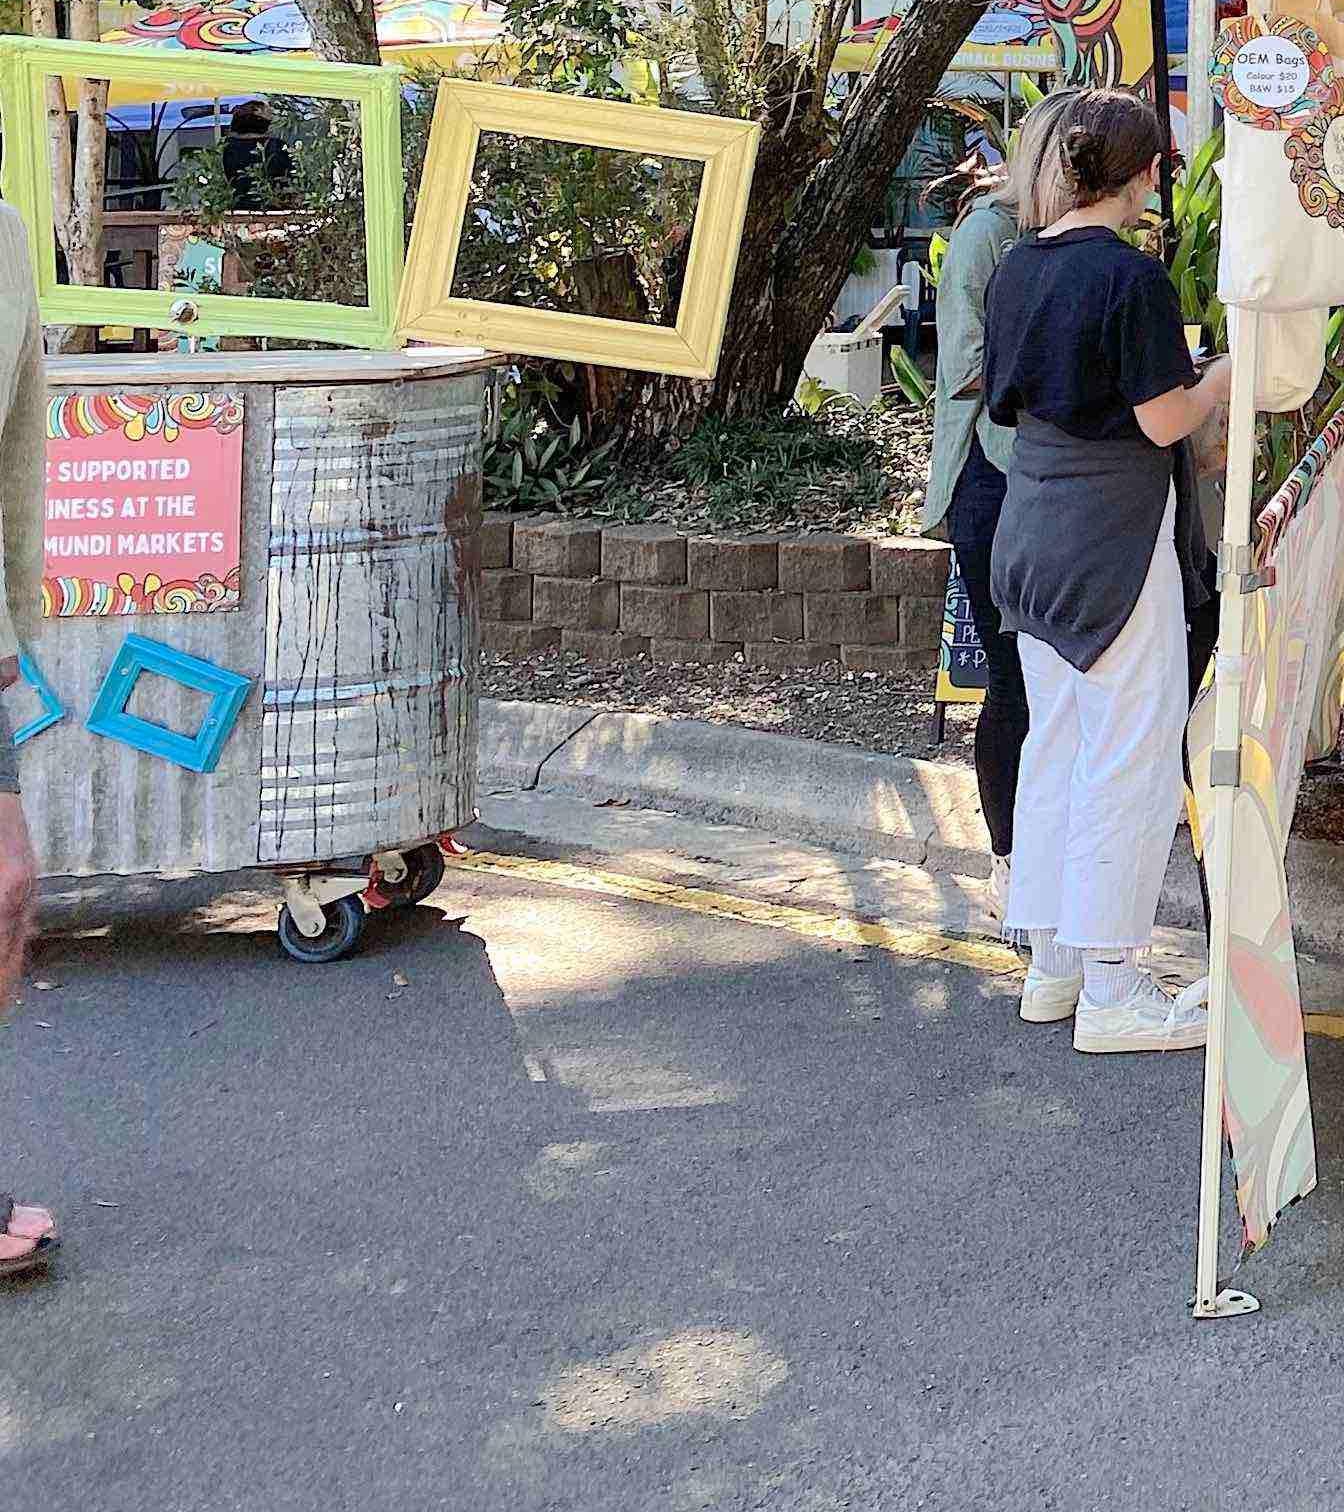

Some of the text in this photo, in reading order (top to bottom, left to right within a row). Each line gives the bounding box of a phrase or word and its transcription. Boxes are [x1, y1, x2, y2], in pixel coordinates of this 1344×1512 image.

[1237, 52, 1305, 68] OEM Bags
[57, 458, 190, 483] SUPPORTED
[47, 495, 196, 520] INESS AT THE
[44, 531, 225, 557] MUNDI MARKETS
